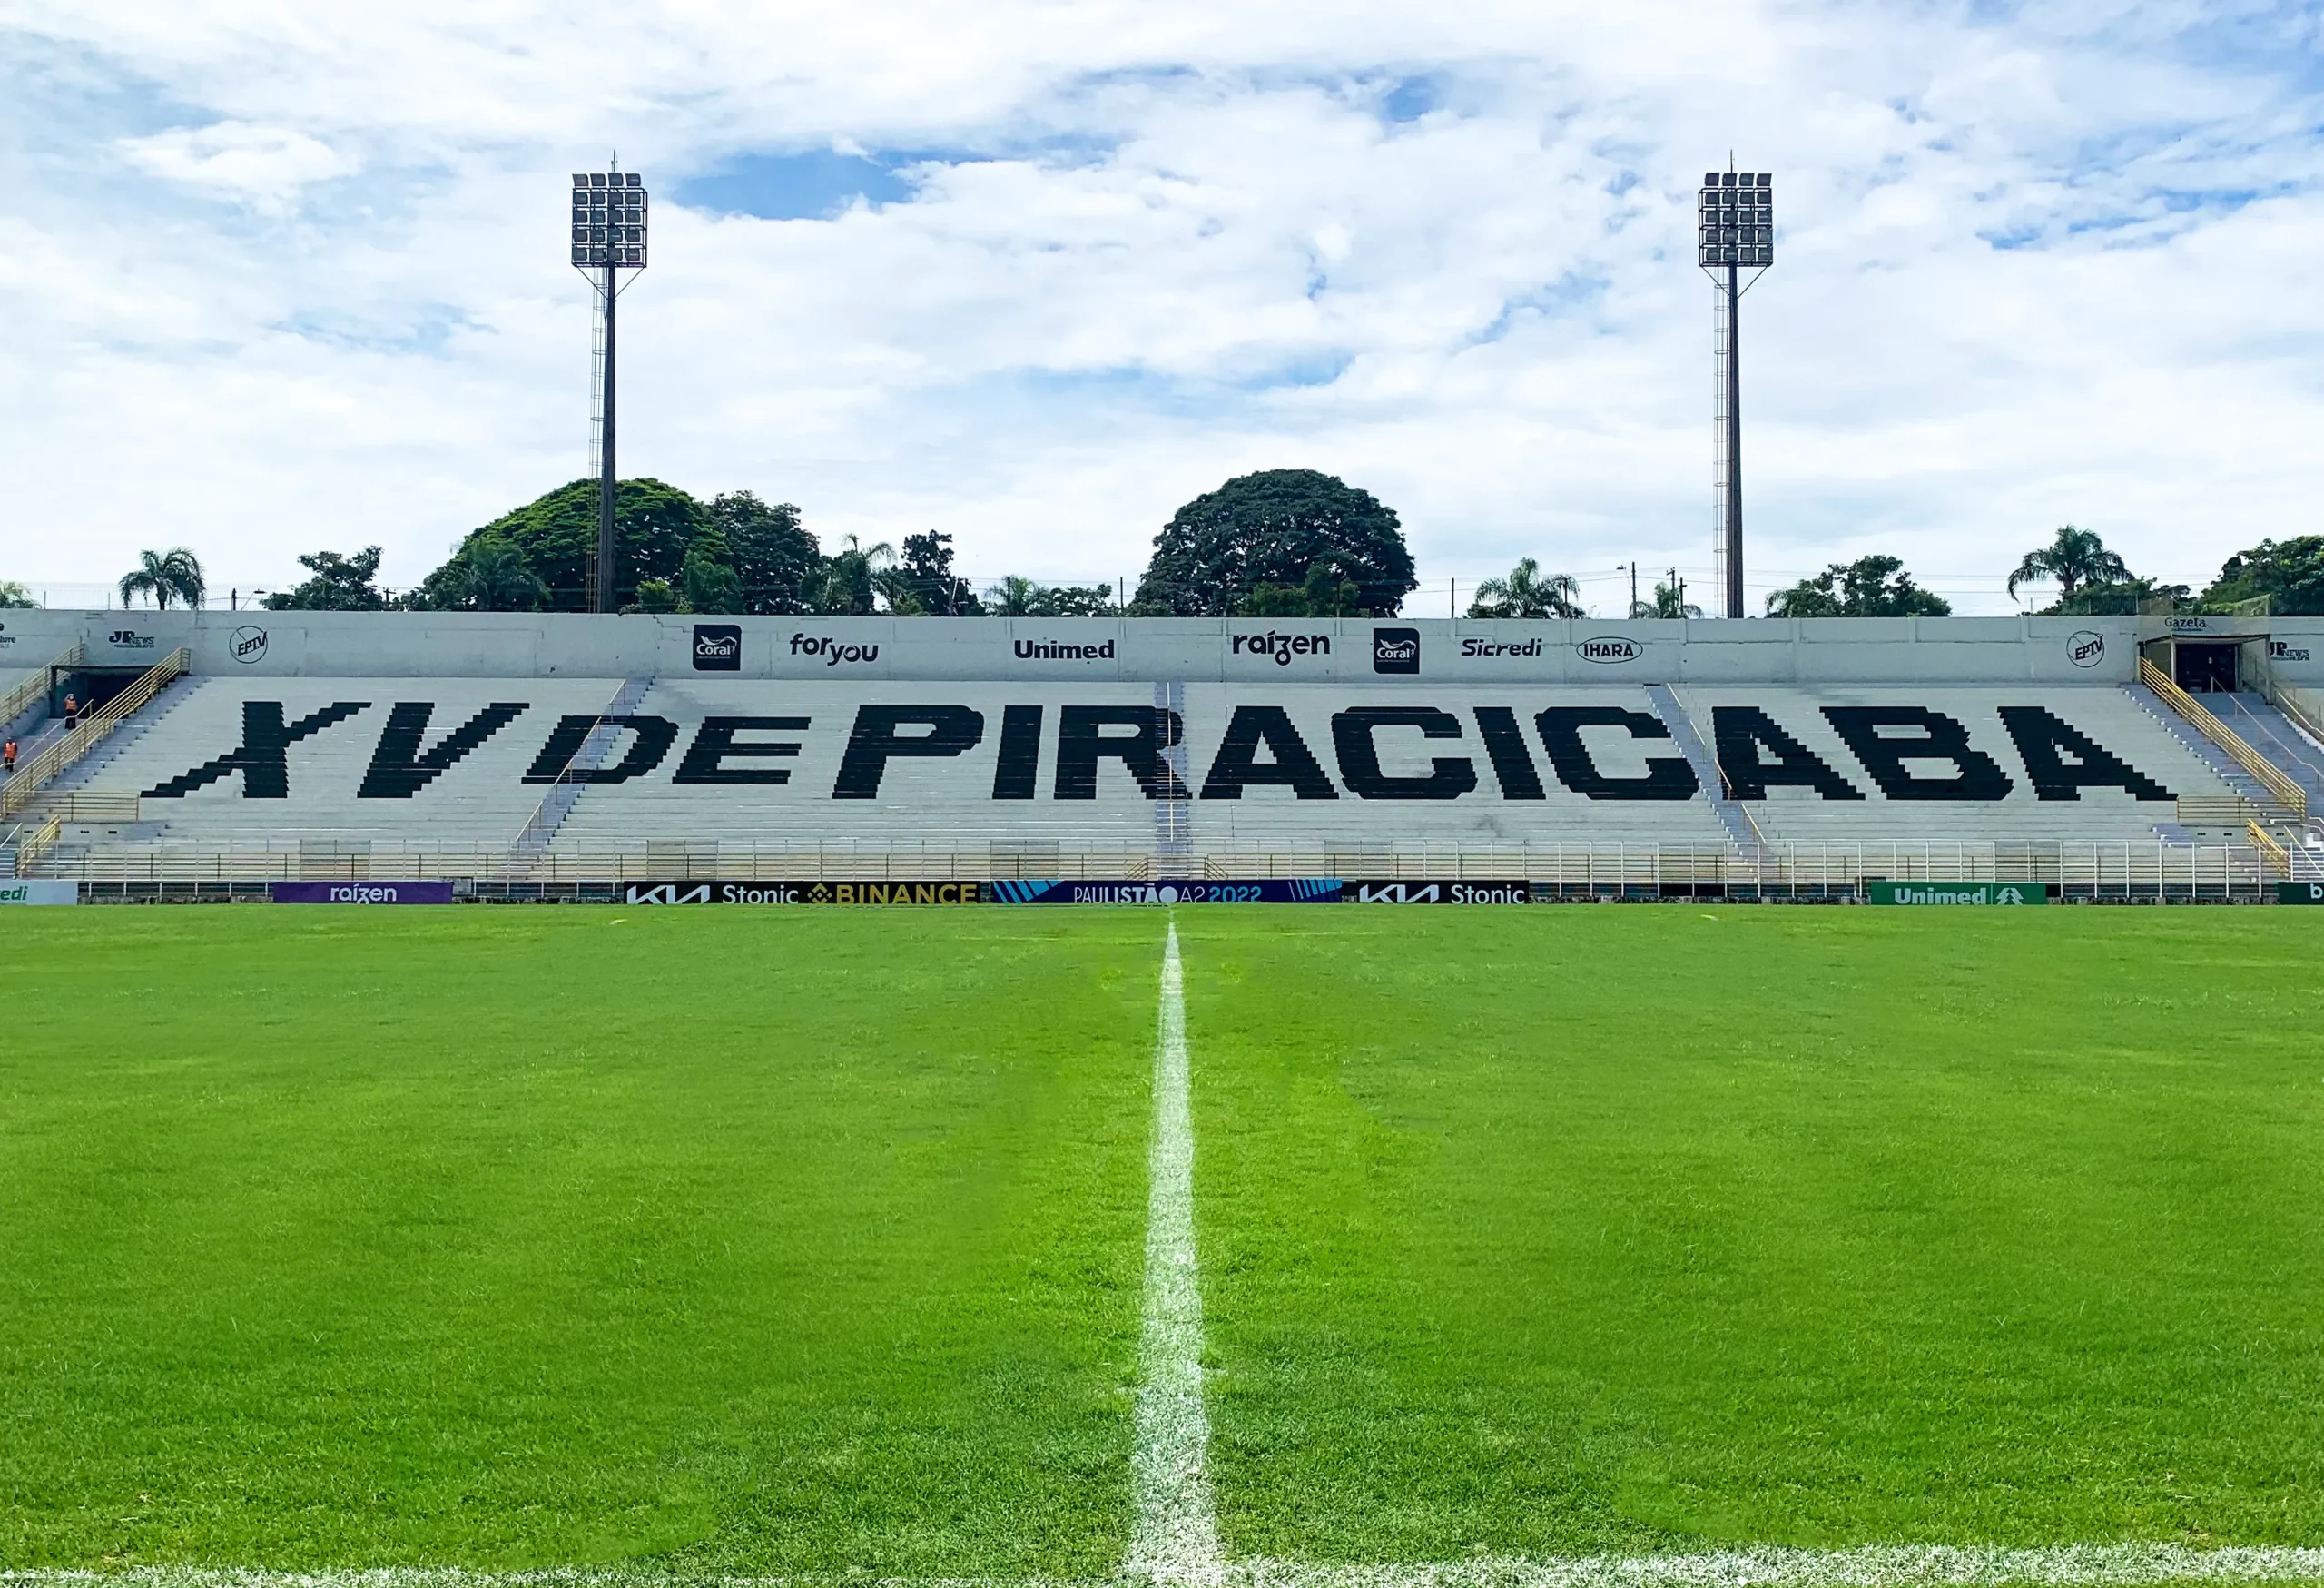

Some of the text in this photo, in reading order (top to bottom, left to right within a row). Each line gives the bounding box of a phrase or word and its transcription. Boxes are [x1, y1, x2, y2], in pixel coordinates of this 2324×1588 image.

[237, 631, 267, 656] EPTV
[695, 643, 731, 656] Coral
[1014, 639, 1115, 660] Unimed
[1233, 629, 1331, 666] raízen
[1376, 646, 1411, 659] Coral
[1461, 637, 1542, 657] Sicredi
[1584, 646, 1635, 658] IHARA
[2074, 635, 2104, 661] EPTV
[140, 700, 2180, 802] XV DE PIRACICABA
[0, 885, 29, 901] edi
[330, 883, 398, 904] raízen
[722, 884, 799, 904] Stonic
[836, 884, 978, 904] BINANCE
[1209, 885, 1263, 904] 2022
[1451, 884, 1526, 904] Stonic
[1894, 886, 1987, 905] Unimed
